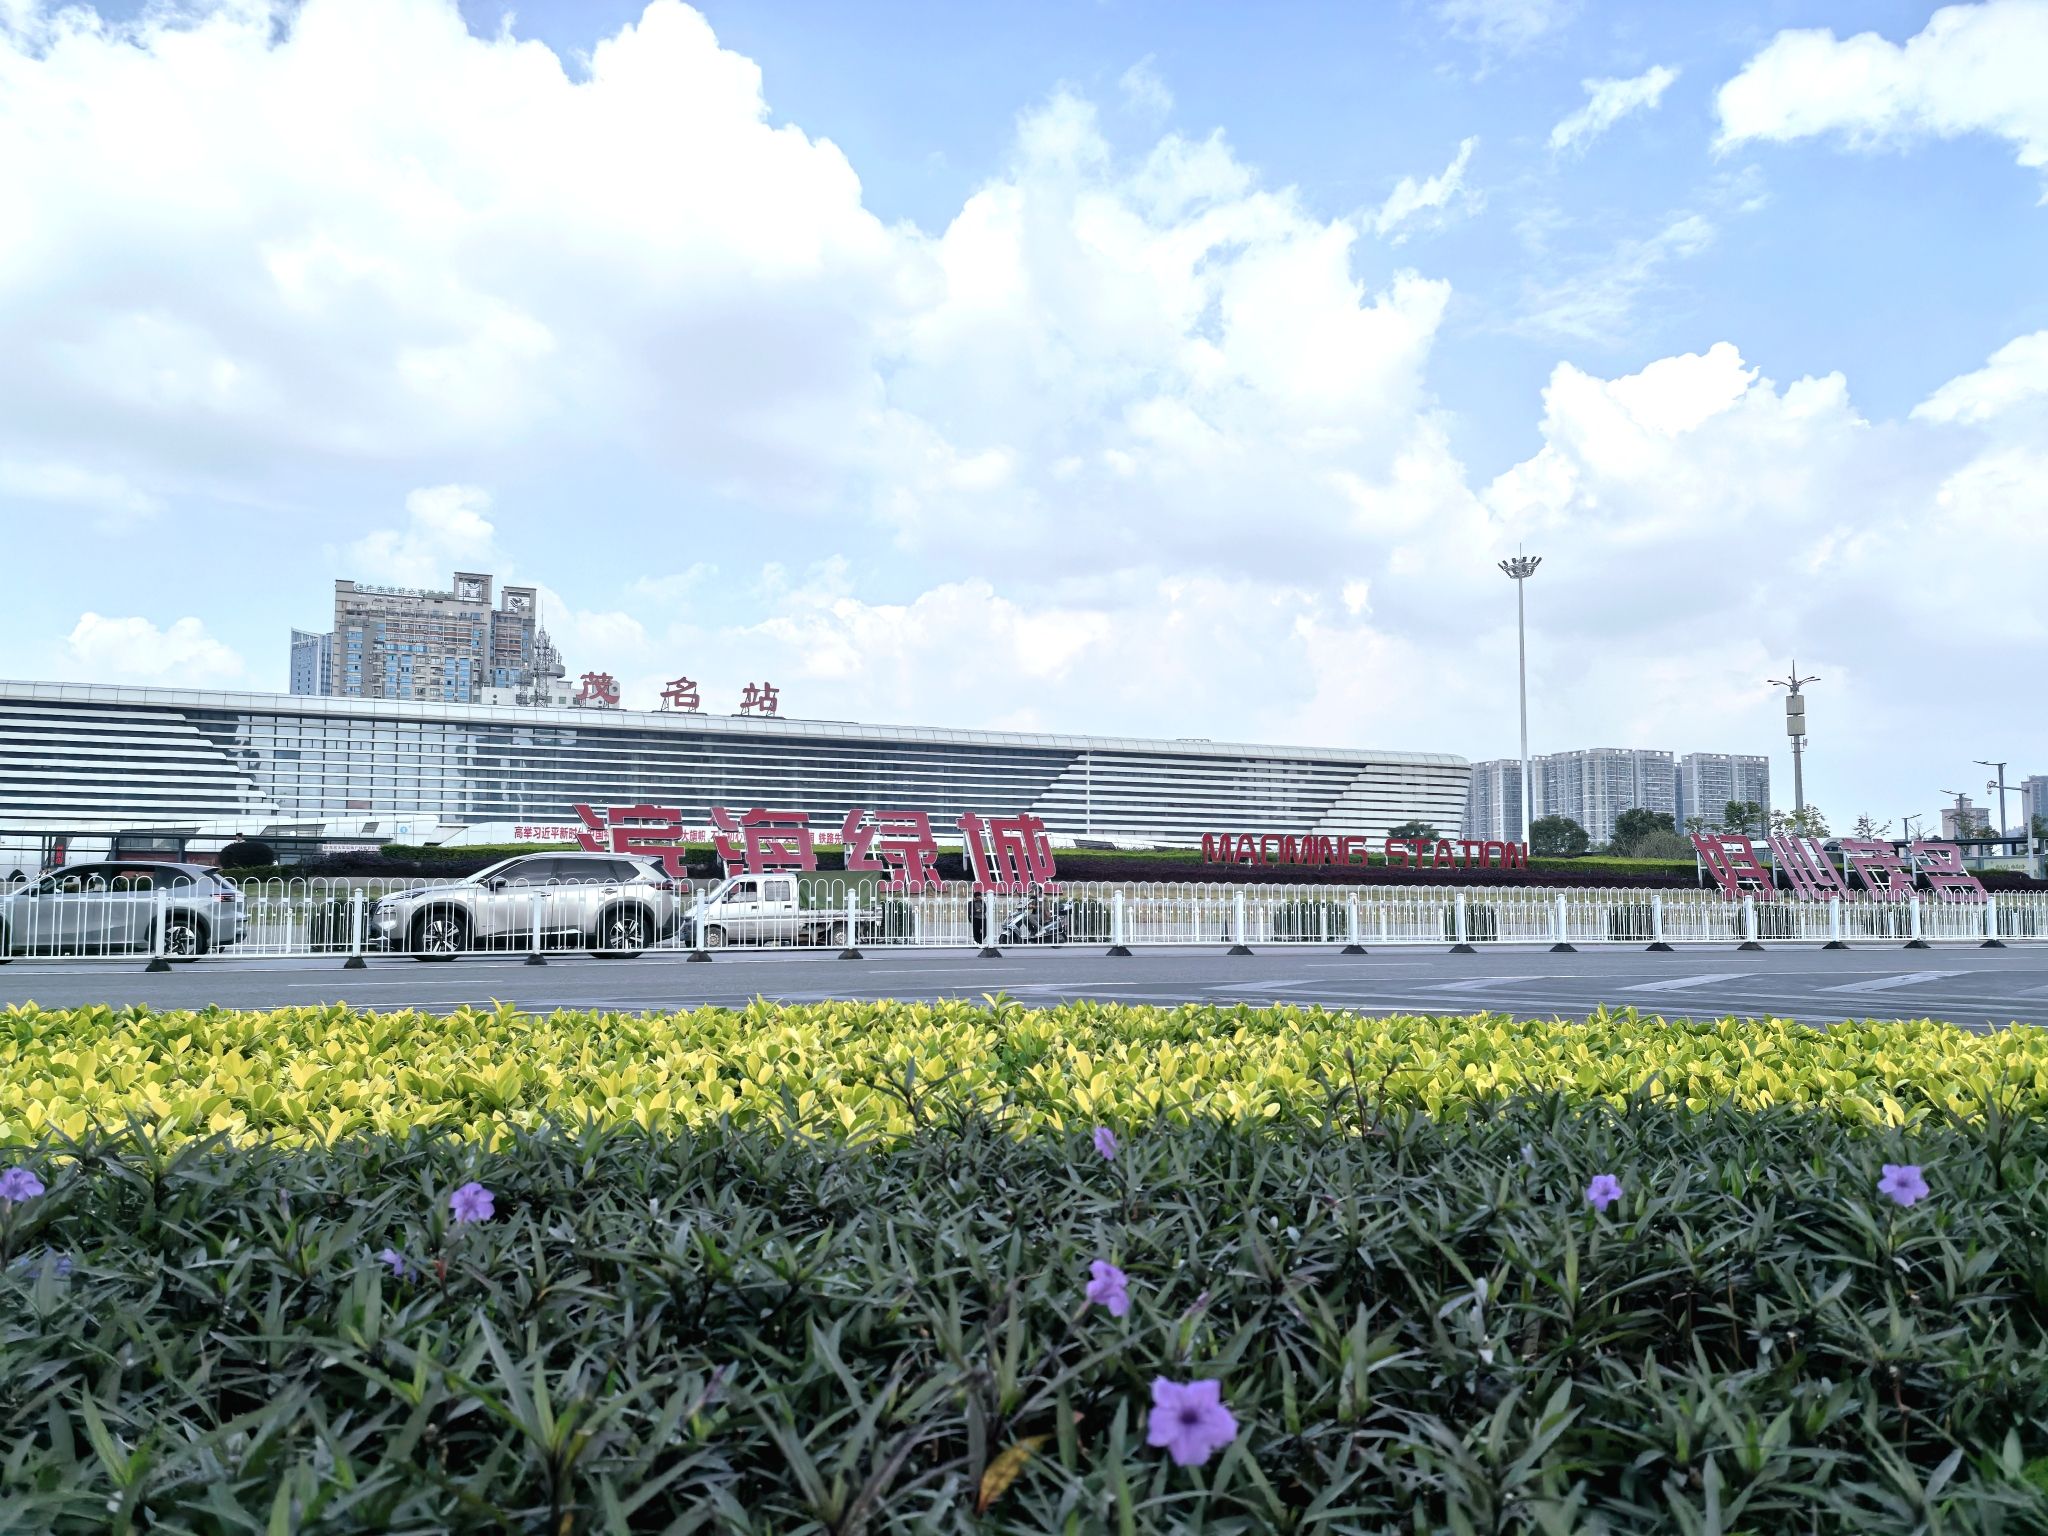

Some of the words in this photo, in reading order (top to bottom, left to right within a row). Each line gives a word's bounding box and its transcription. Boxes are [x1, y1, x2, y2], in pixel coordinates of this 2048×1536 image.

[575, 671, 780, 712] 茂名站
[573, 803, 1064, 895] 滨海绿城
[1201, 832, 1368, 867] MAOMING
[1384, 838, 1528, 870] STATION
